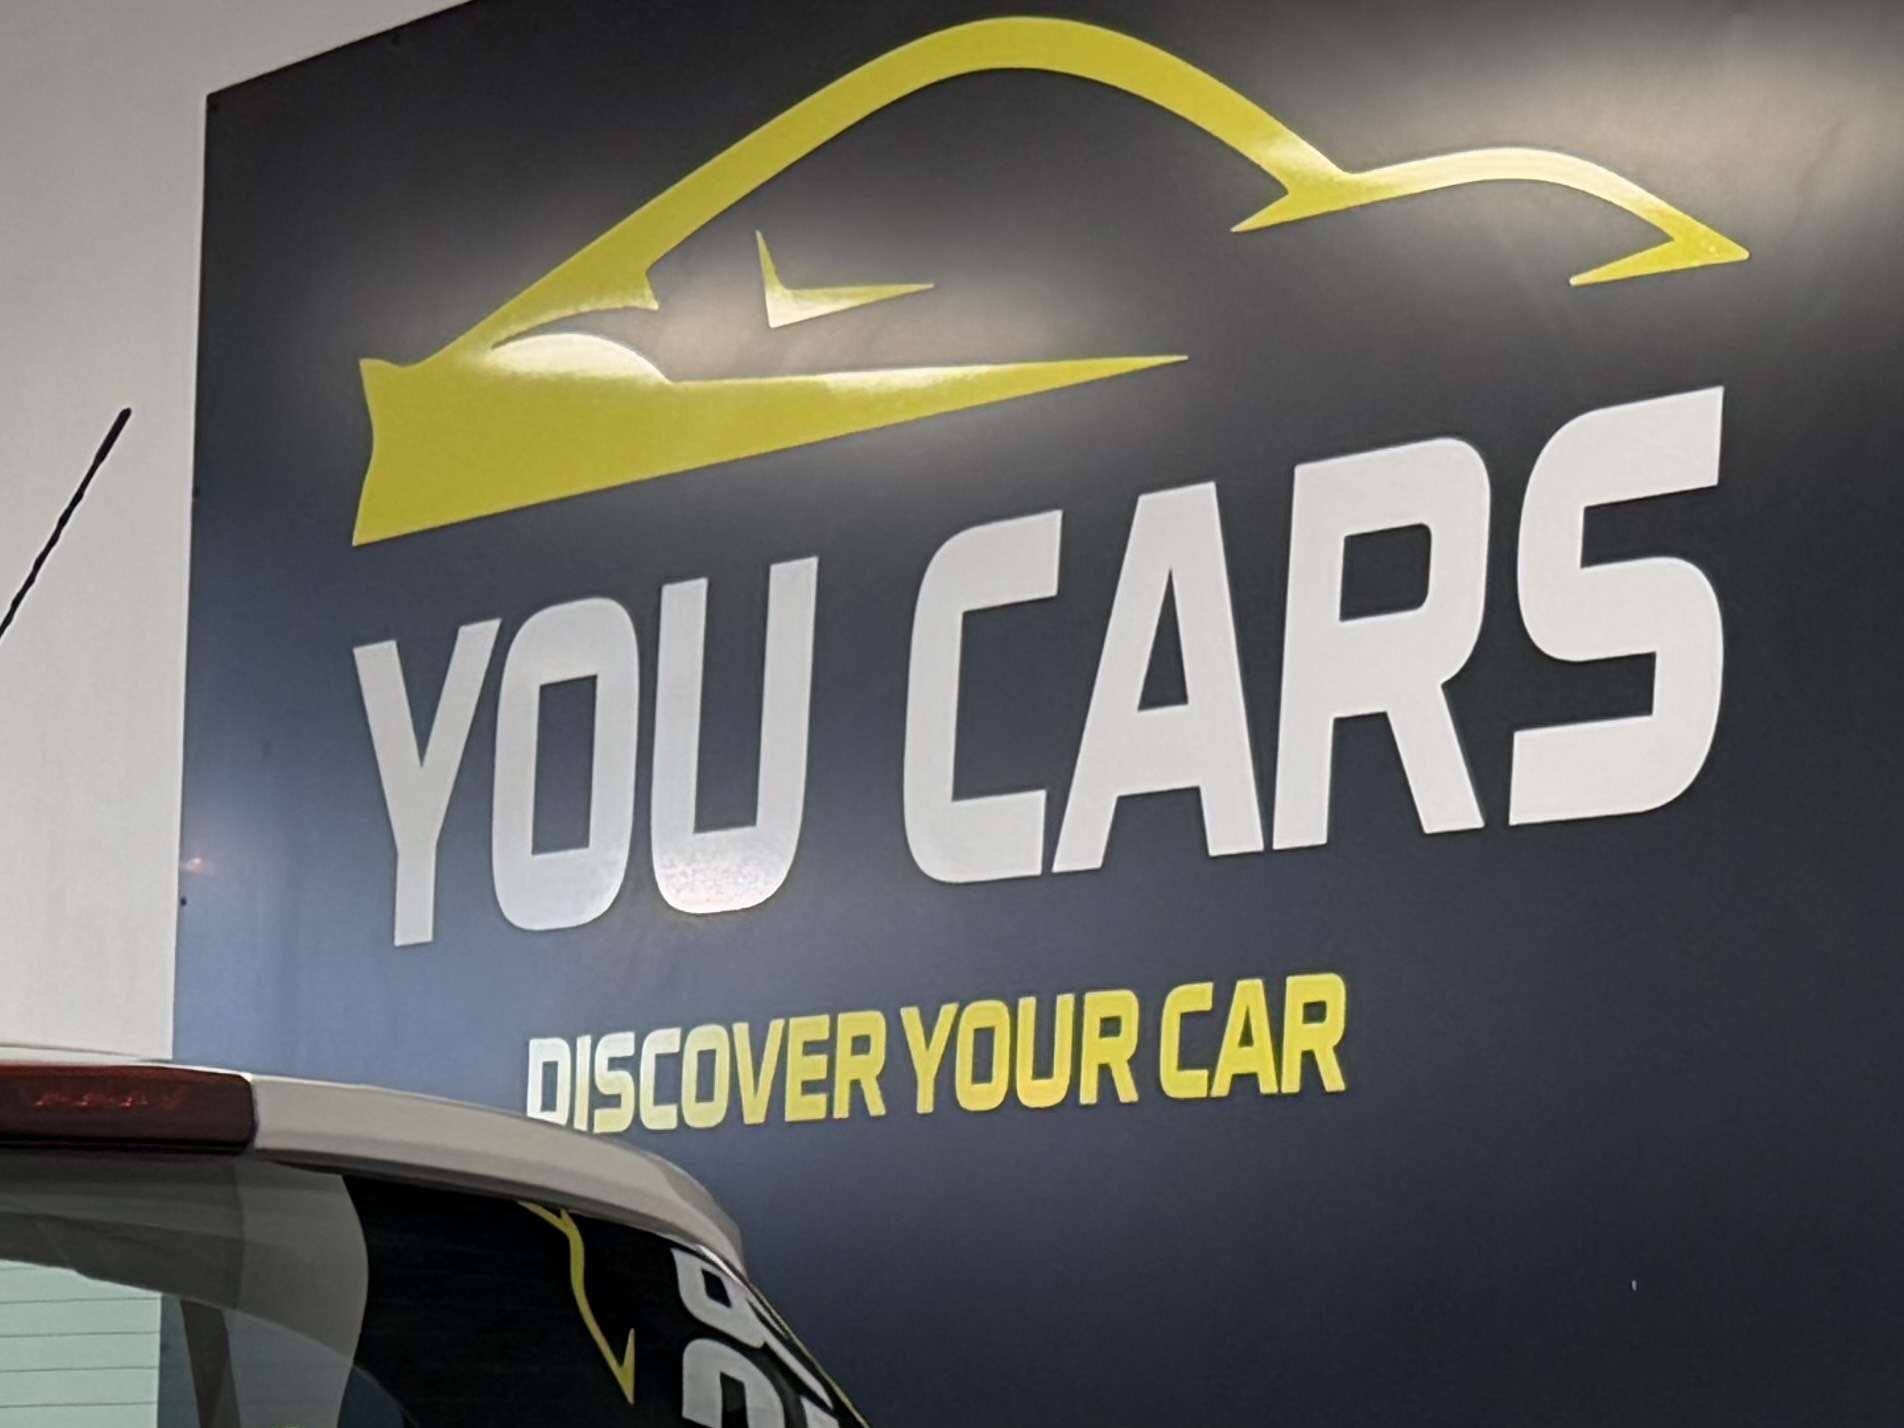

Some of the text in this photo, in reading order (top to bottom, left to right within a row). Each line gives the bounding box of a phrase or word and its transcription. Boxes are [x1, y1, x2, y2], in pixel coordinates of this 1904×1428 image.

[354, 387, 1725, 946] YOU CARS
[526, 973, 1347, 1133] DISCOVER YOUR CAR
